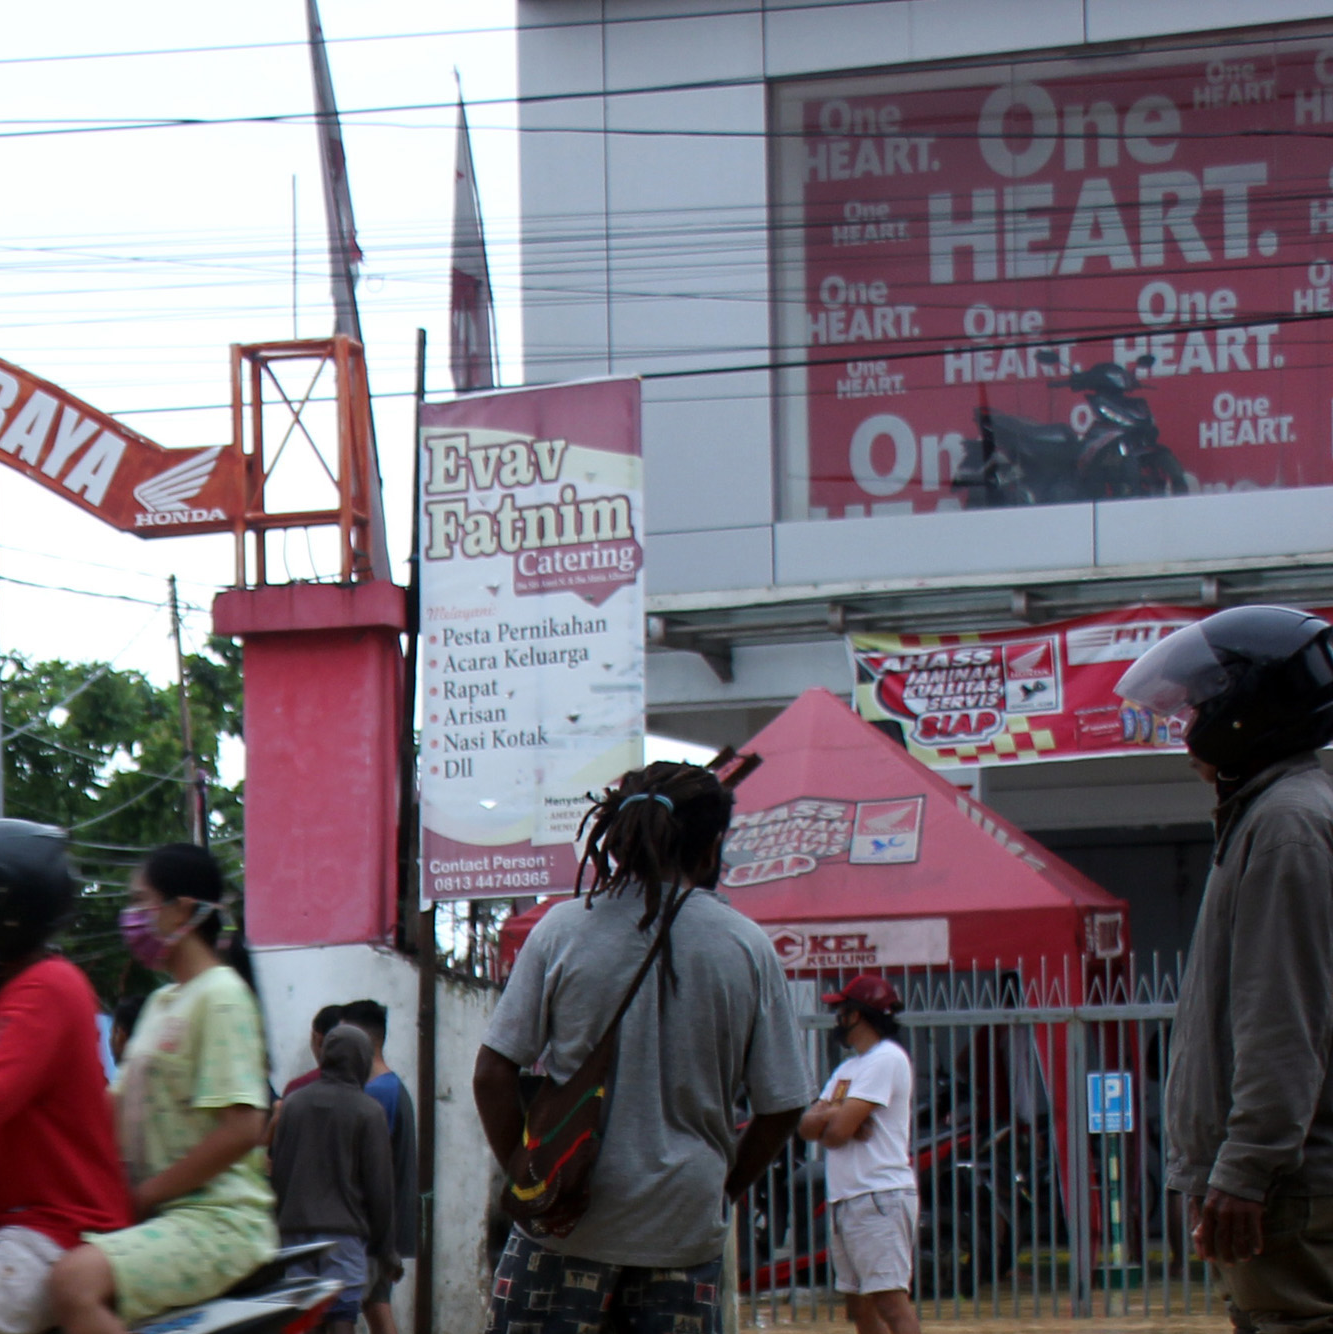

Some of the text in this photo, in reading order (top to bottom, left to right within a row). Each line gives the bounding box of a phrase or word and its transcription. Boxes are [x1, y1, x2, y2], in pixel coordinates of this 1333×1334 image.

[819, 98, 902, 136] One
[978, 82, 1182, 178] One
[804, 136, 941, 183] HEART.
[929, 162, 1280, 284] HEART.
[819, 276, 888, 310] One
[1137, 281, 1238, 329] One
[807, 306, 921, 345] HEART.
[963, 304, 1044, 342] One
[1113, 323, 1285, 380] HEART.
[1212, 391, 1271, 420] One
[1198, 415, 1297, 449] HEART.
[425, 433, 569, 495] Evav
[134, 506, 227, 528] HONDA
[425, 484, 634, 560] Fatnim
[517, 543, 636, 577] Catering
[443, 614, 607, 648] Pesta Pernikahan
[443, 646, 590, 674] Acara Keluarga
[879, 649, 995, 672] AHASS
[443, 679, 498, 704] Rapat
[443, 706, 507, 727] Arisan
[918, 711, 997, 739] SIAP
[443, 725, 549, 753] Nasi Kotak
[443, 757, 473, 779] Dll
[429, 856, 490, 875] Contact
[492, 854, 546, 871] Person
[726, 856, 813, 884] SIAP
[434, 873, 471, 891] 0813
[1104, 1078, 1122, 1110] P
